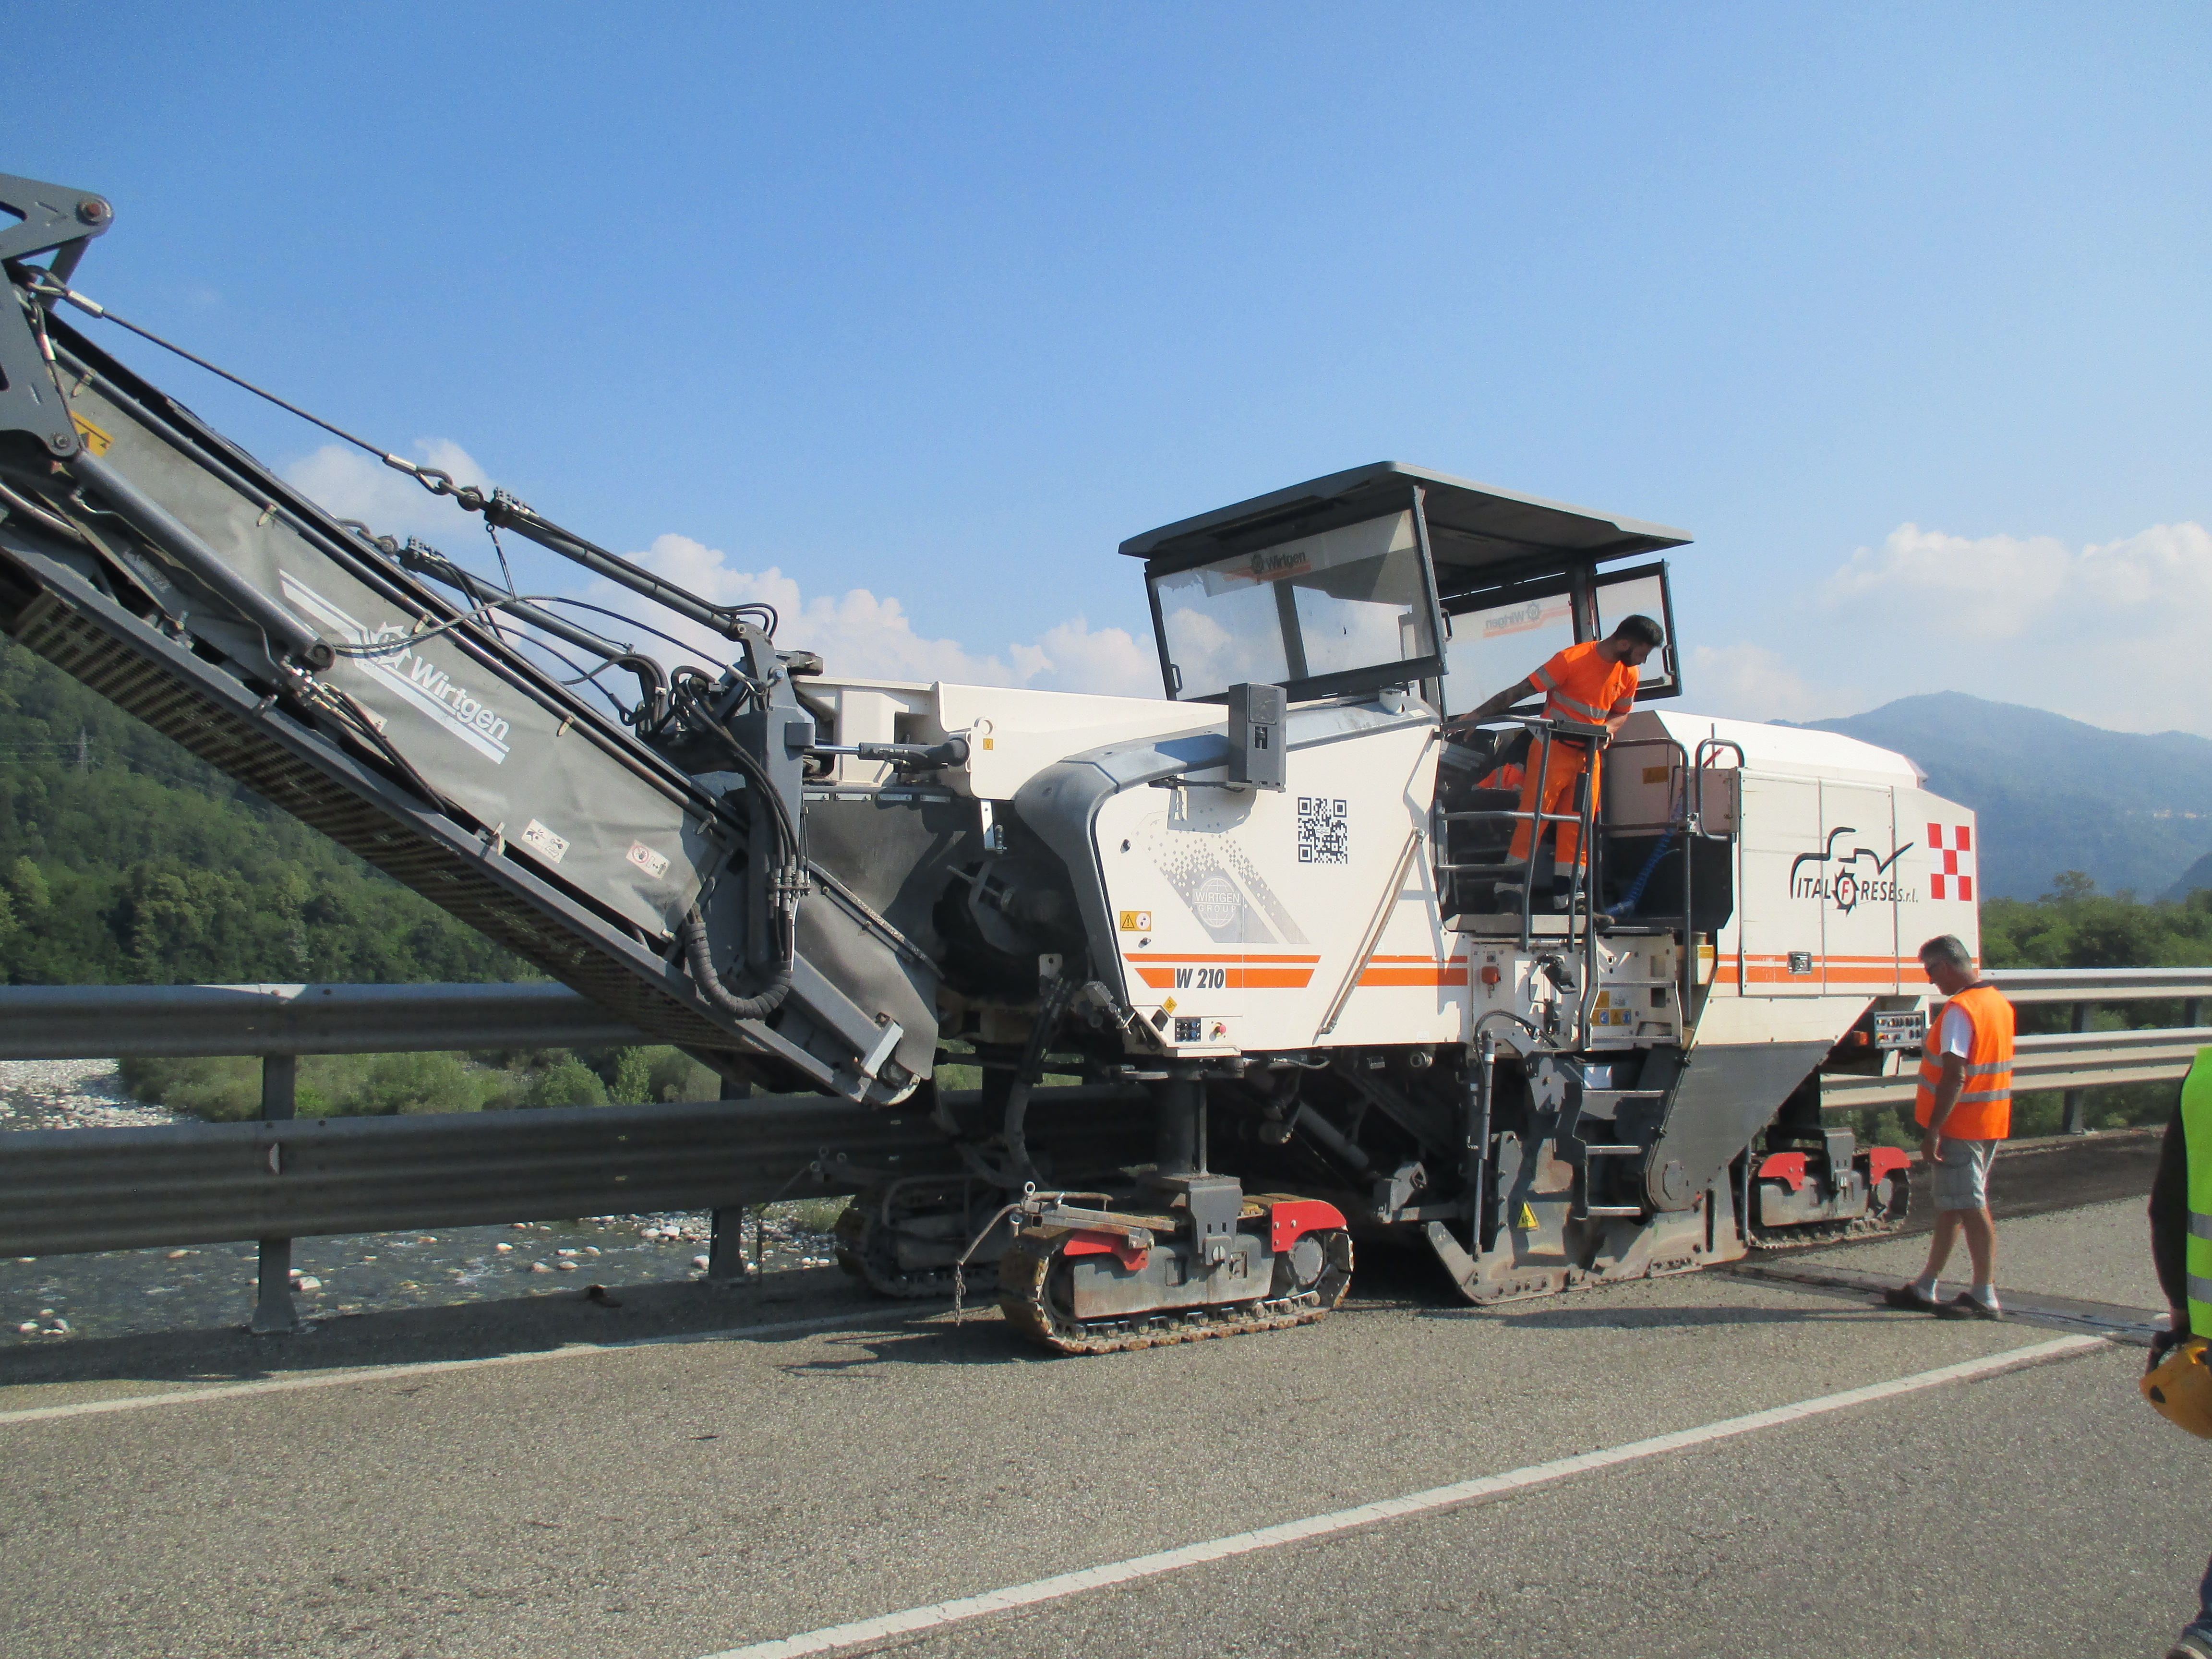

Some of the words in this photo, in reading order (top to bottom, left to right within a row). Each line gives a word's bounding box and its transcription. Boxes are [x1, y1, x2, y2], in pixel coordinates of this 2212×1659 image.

[411, 656, 510, 741] Wirtgen
[1195, 891, 1239, 903] WIRTGEN
[1198, 904, 1236, 913] GROUP
[1177, 968, 1193, 988] W
[1196, 968, 1224, 988] 210
